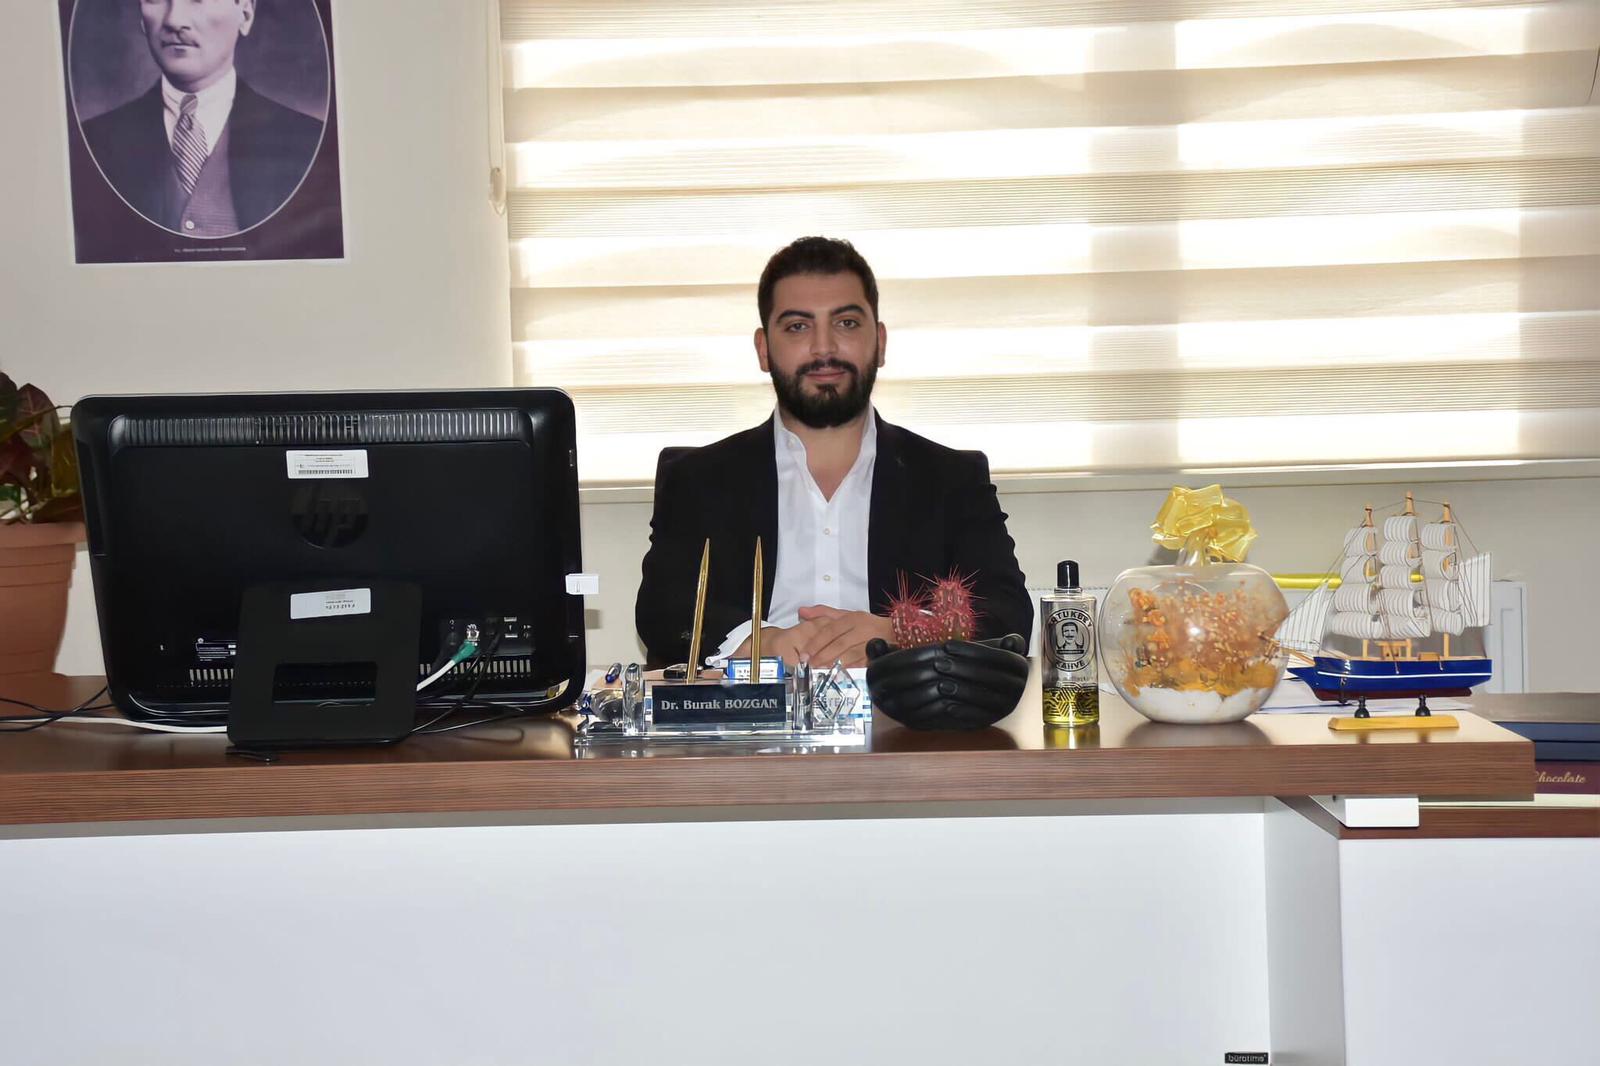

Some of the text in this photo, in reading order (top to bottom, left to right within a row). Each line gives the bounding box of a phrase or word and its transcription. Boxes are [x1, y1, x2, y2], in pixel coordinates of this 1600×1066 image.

[661, 699, 778, 710] Dr. Burak BOZGAN
